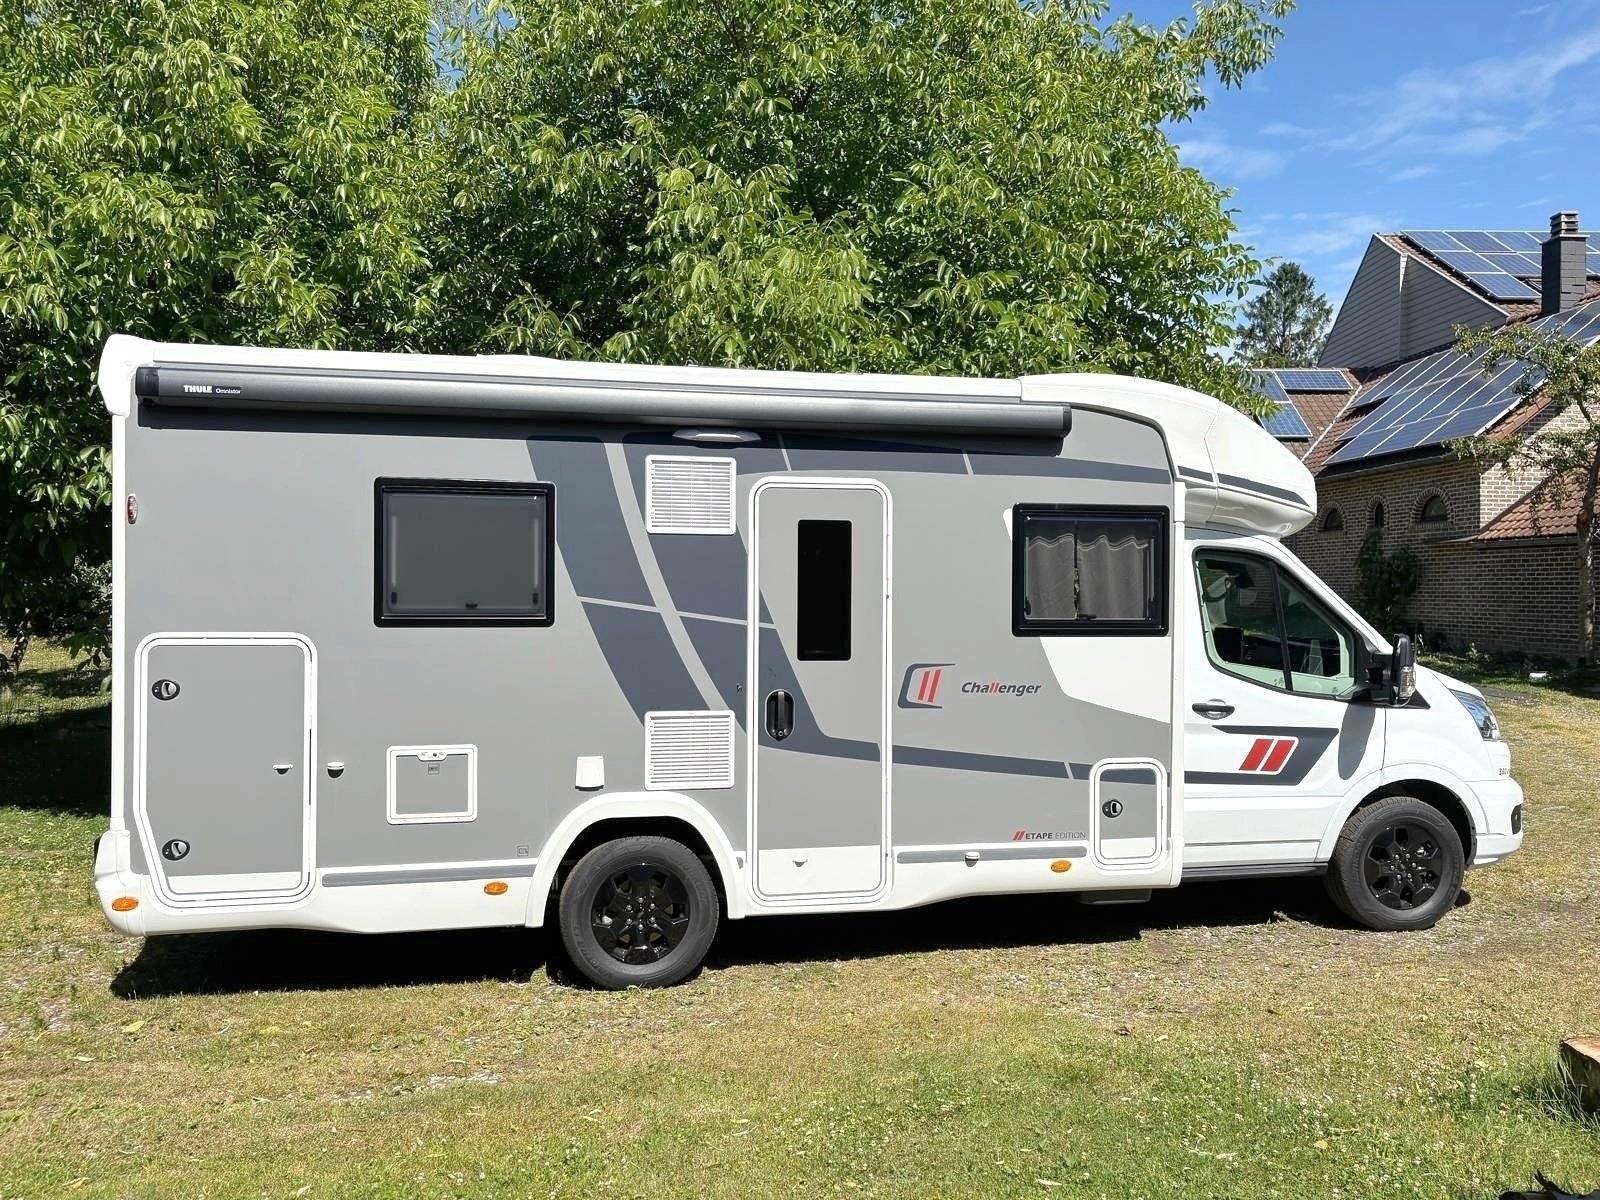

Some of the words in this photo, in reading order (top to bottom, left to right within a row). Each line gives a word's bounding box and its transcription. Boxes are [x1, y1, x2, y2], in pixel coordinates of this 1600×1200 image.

[183, 384, 212, 393] THULE
[961, 682, 1041, 697] Challenger
[1025, 832, 1053, 840] ETAPE
[1055, 831, 1086, 839] EDITION
